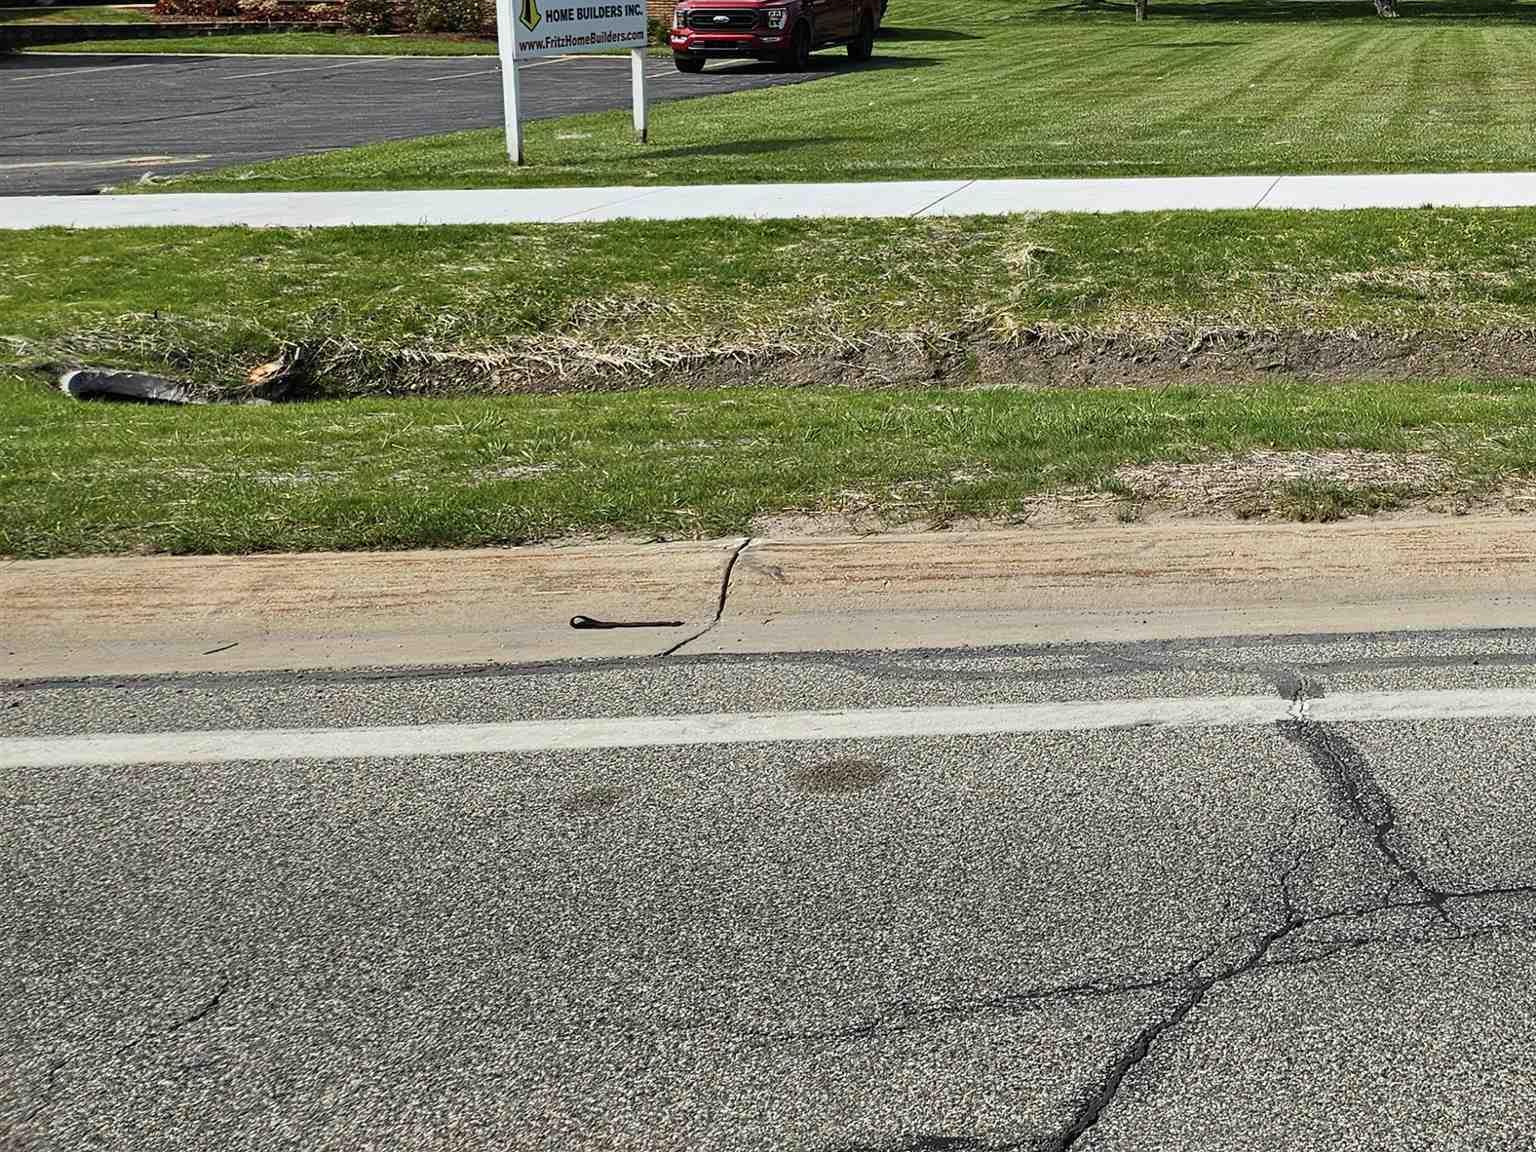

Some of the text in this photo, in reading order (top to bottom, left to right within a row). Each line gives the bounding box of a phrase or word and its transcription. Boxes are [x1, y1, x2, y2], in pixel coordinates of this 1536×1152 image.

[545, 4, 643, 22] HOME BUILDERS INC.
[519, 31, 644, 51] www.FritzHomeBuilders.com
